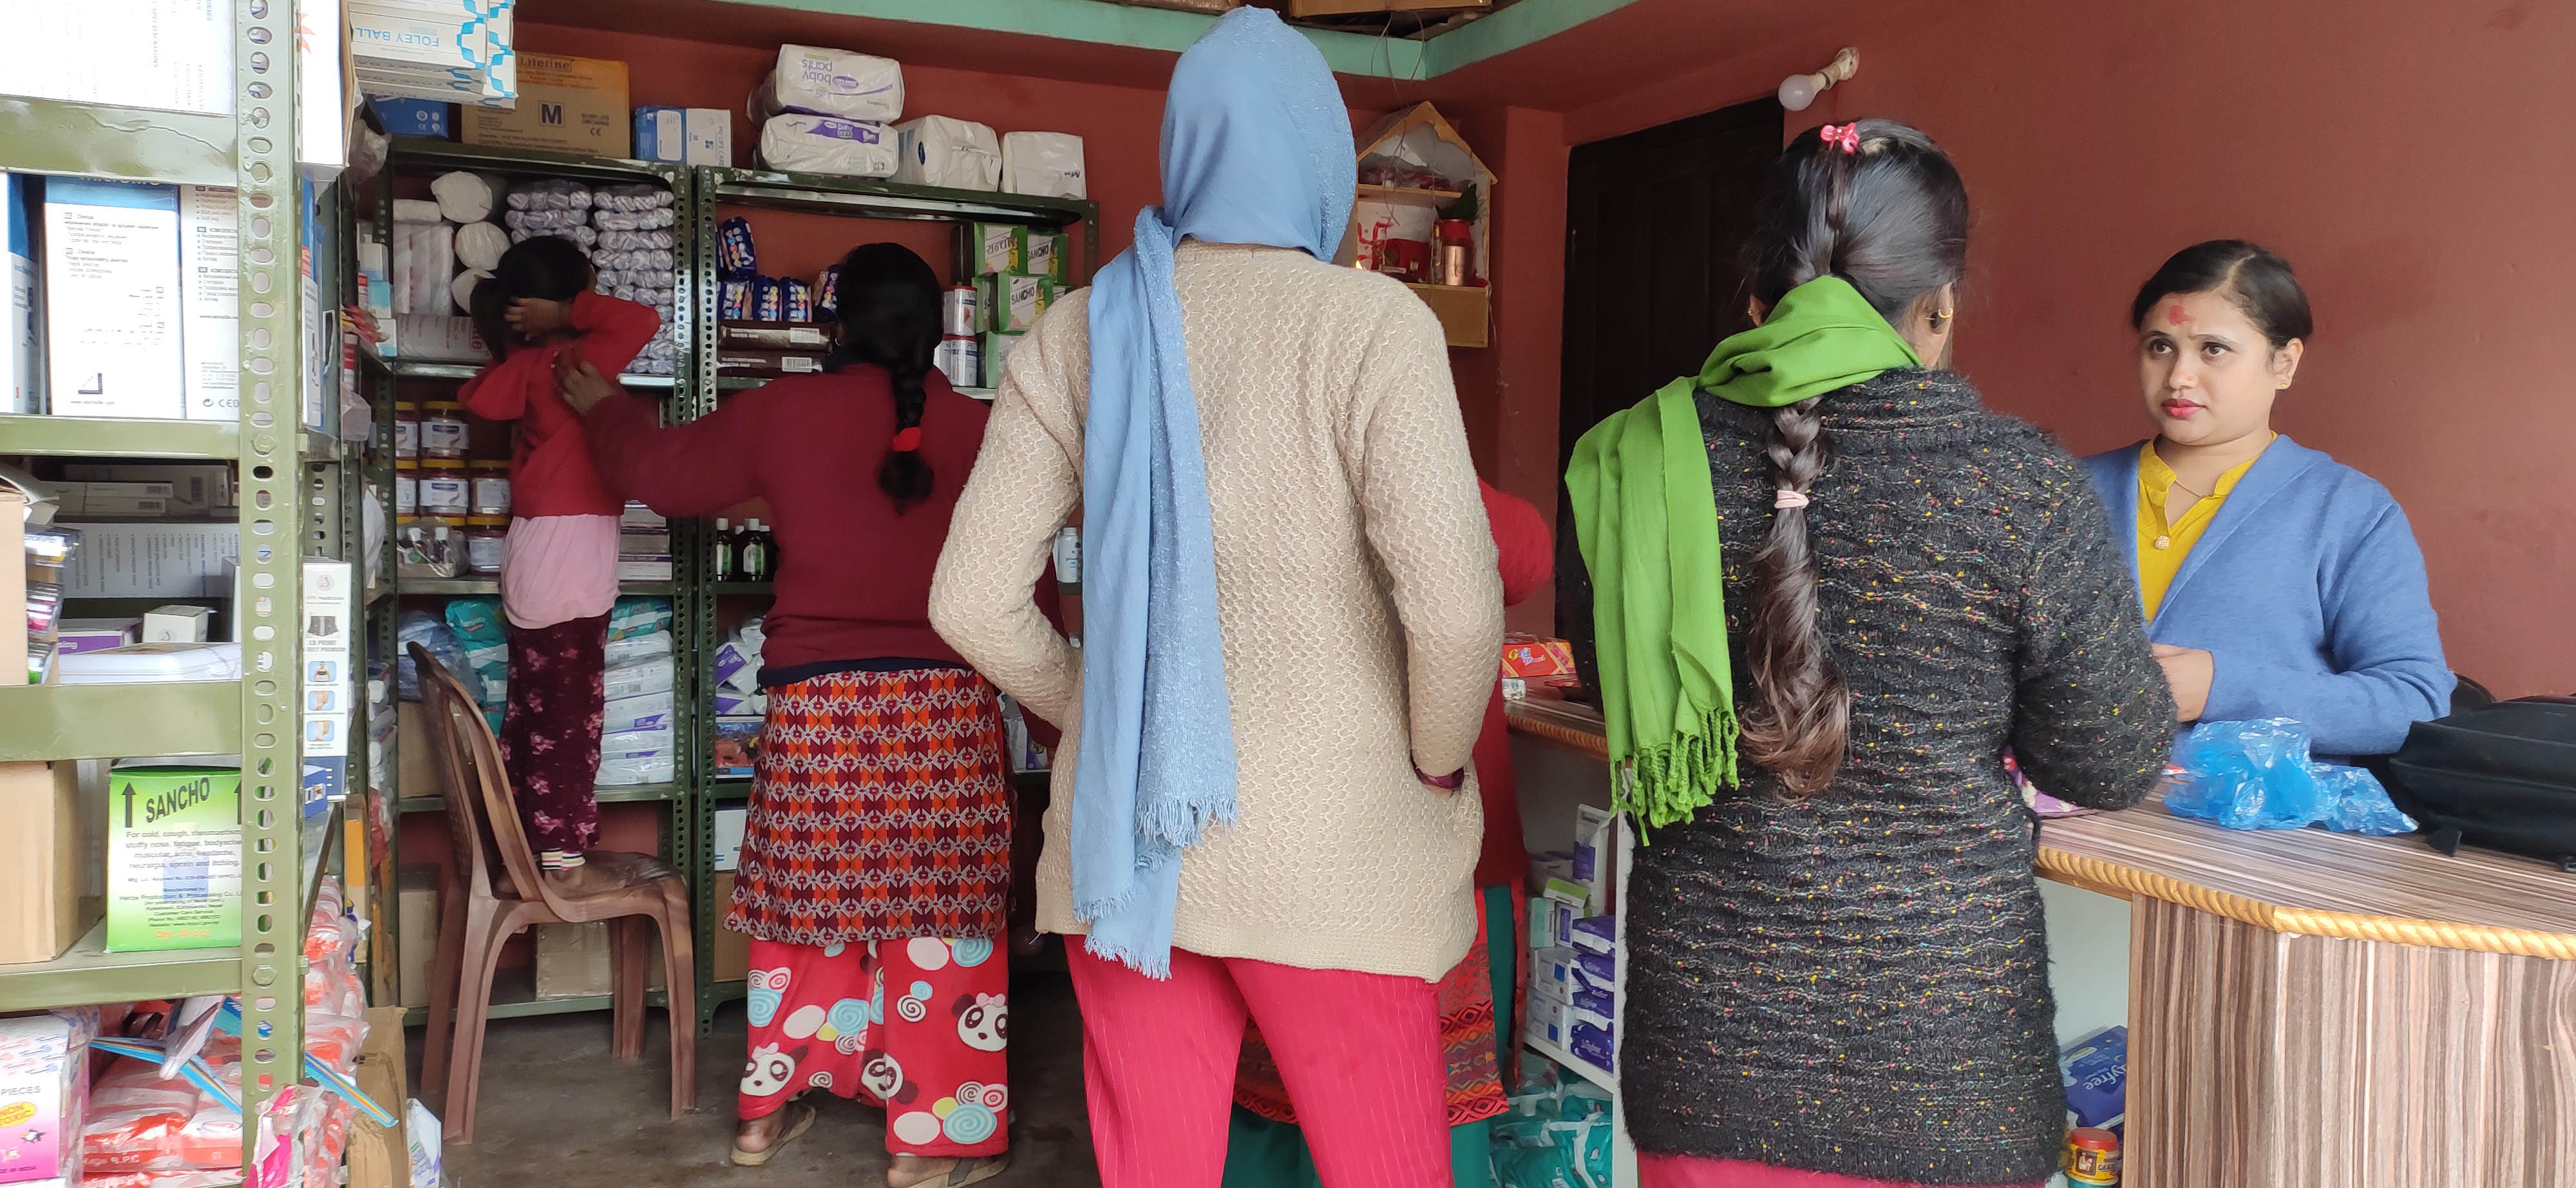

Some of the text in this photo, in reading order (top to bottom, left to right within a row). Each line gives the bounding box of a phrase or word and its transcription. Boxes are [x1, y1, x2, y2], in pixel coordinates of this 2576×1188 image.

[355, 27, 439, 47] FOLEY BALL
[801, 59, 833, 72] pants
[802, 72, 831, 86] baby
[541, 104, 562, 125] M
[1011, 287, 1035, 305] SANCHO
[146, 777, 210, 823] SANCHO
[1, 1086, 41, 1096] PIECES
